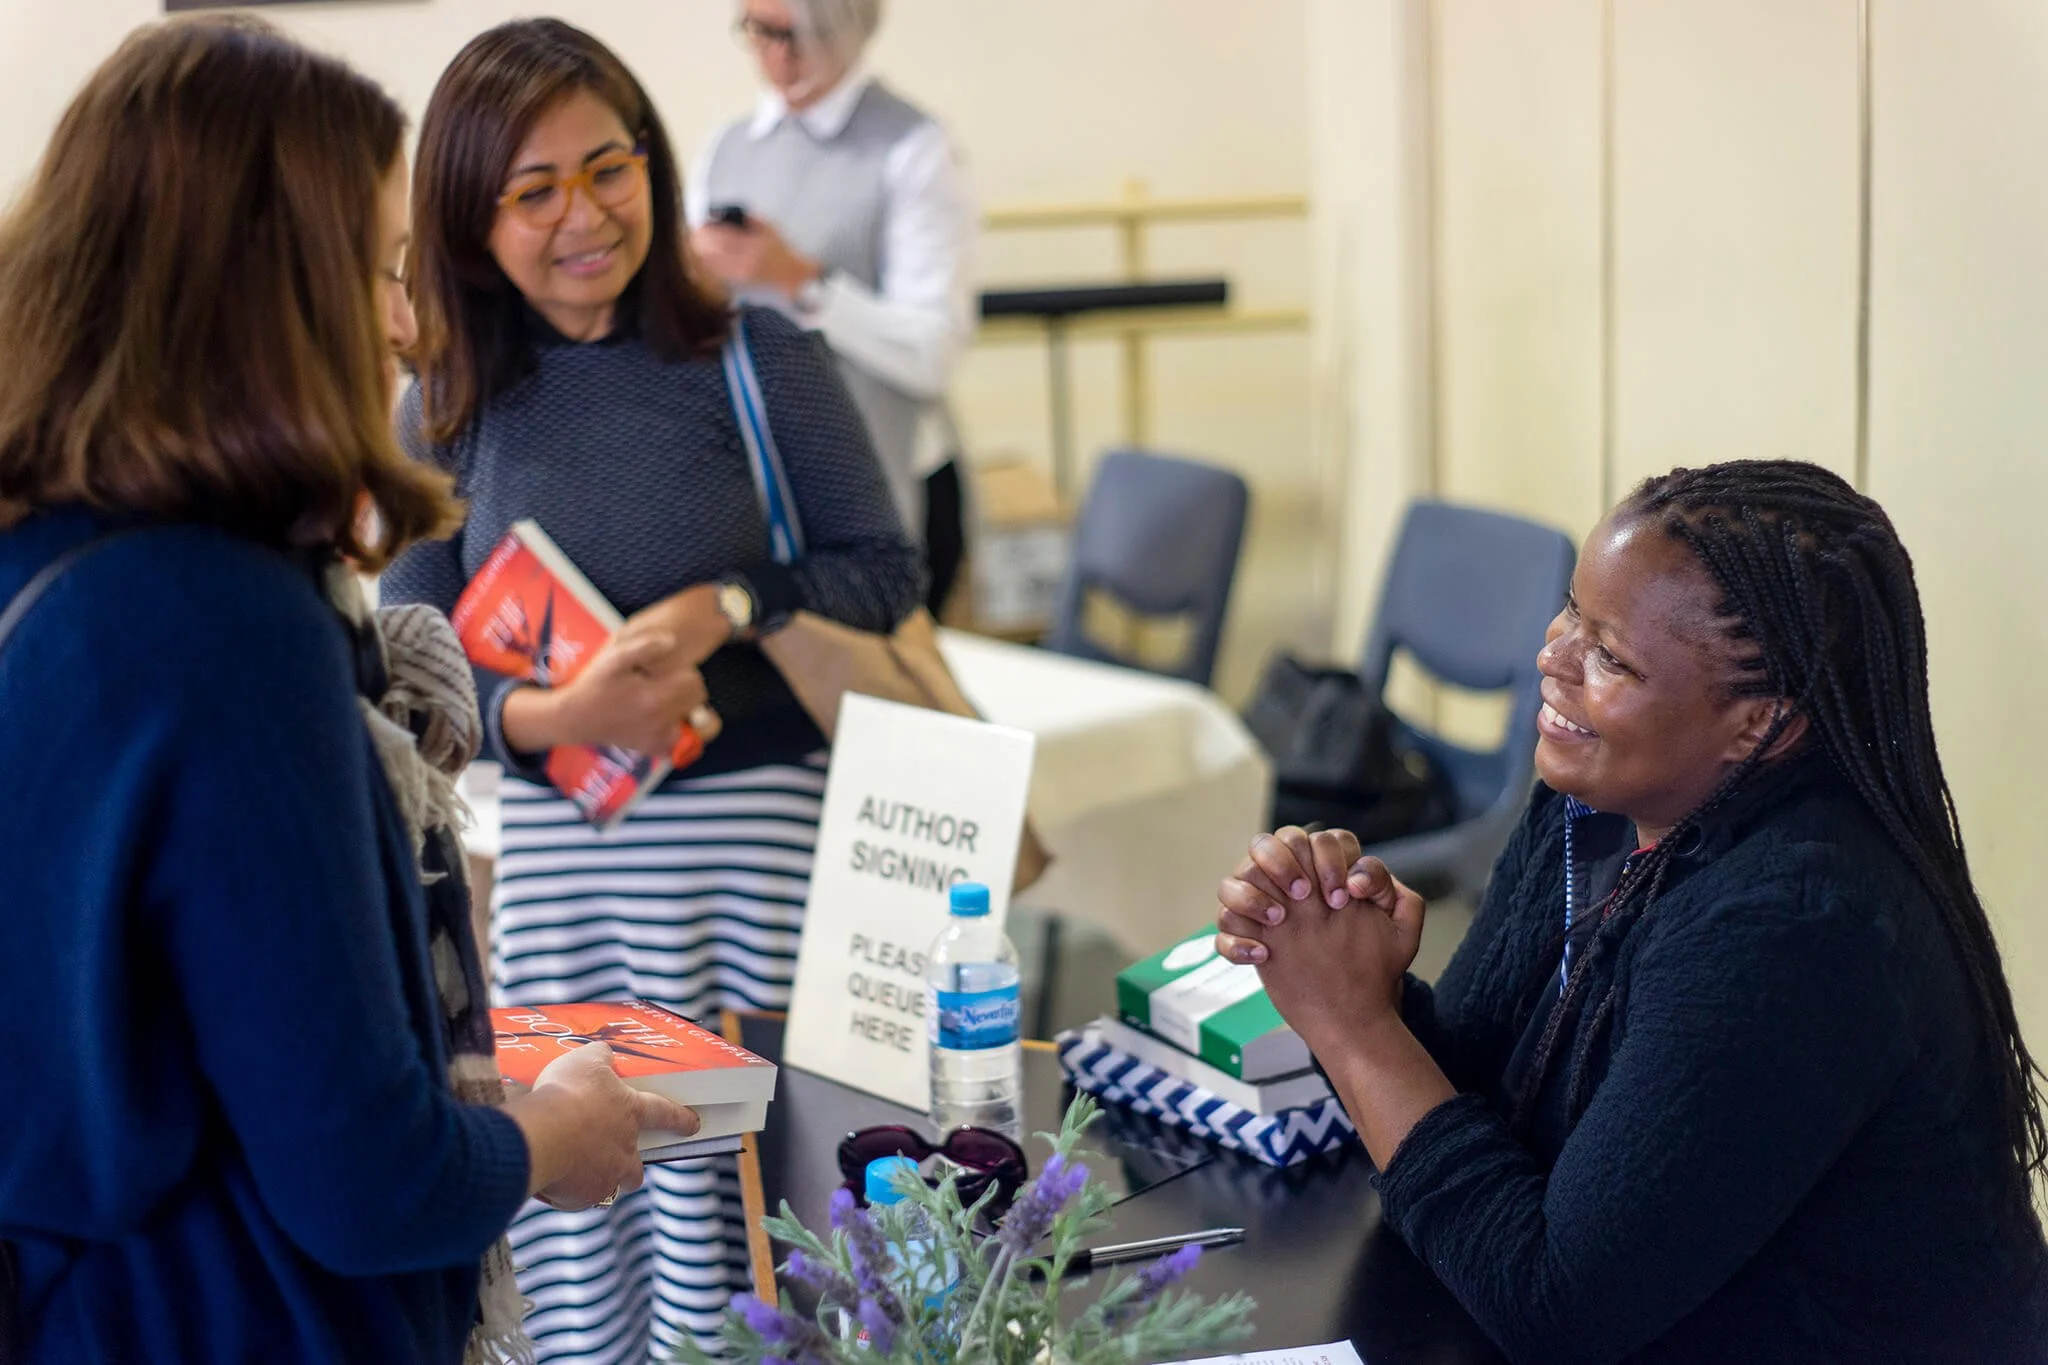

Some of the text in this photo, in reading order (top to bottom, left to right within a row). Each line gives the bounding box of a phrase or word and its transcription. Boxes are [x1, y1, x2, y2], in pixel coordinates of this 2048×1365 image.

[856, 795, 979, 854] AUTHOR
[849, 933, 927, 976] PLEAS
[847, 972, 926, 1018] QUEUE
[505, 1013, 631, 1061] BOO
[607, 1017, 684, 1047] THE
[688, 1029, 763, 1064] GAPPAH
[850, 1010, 914, 1053] HERE
